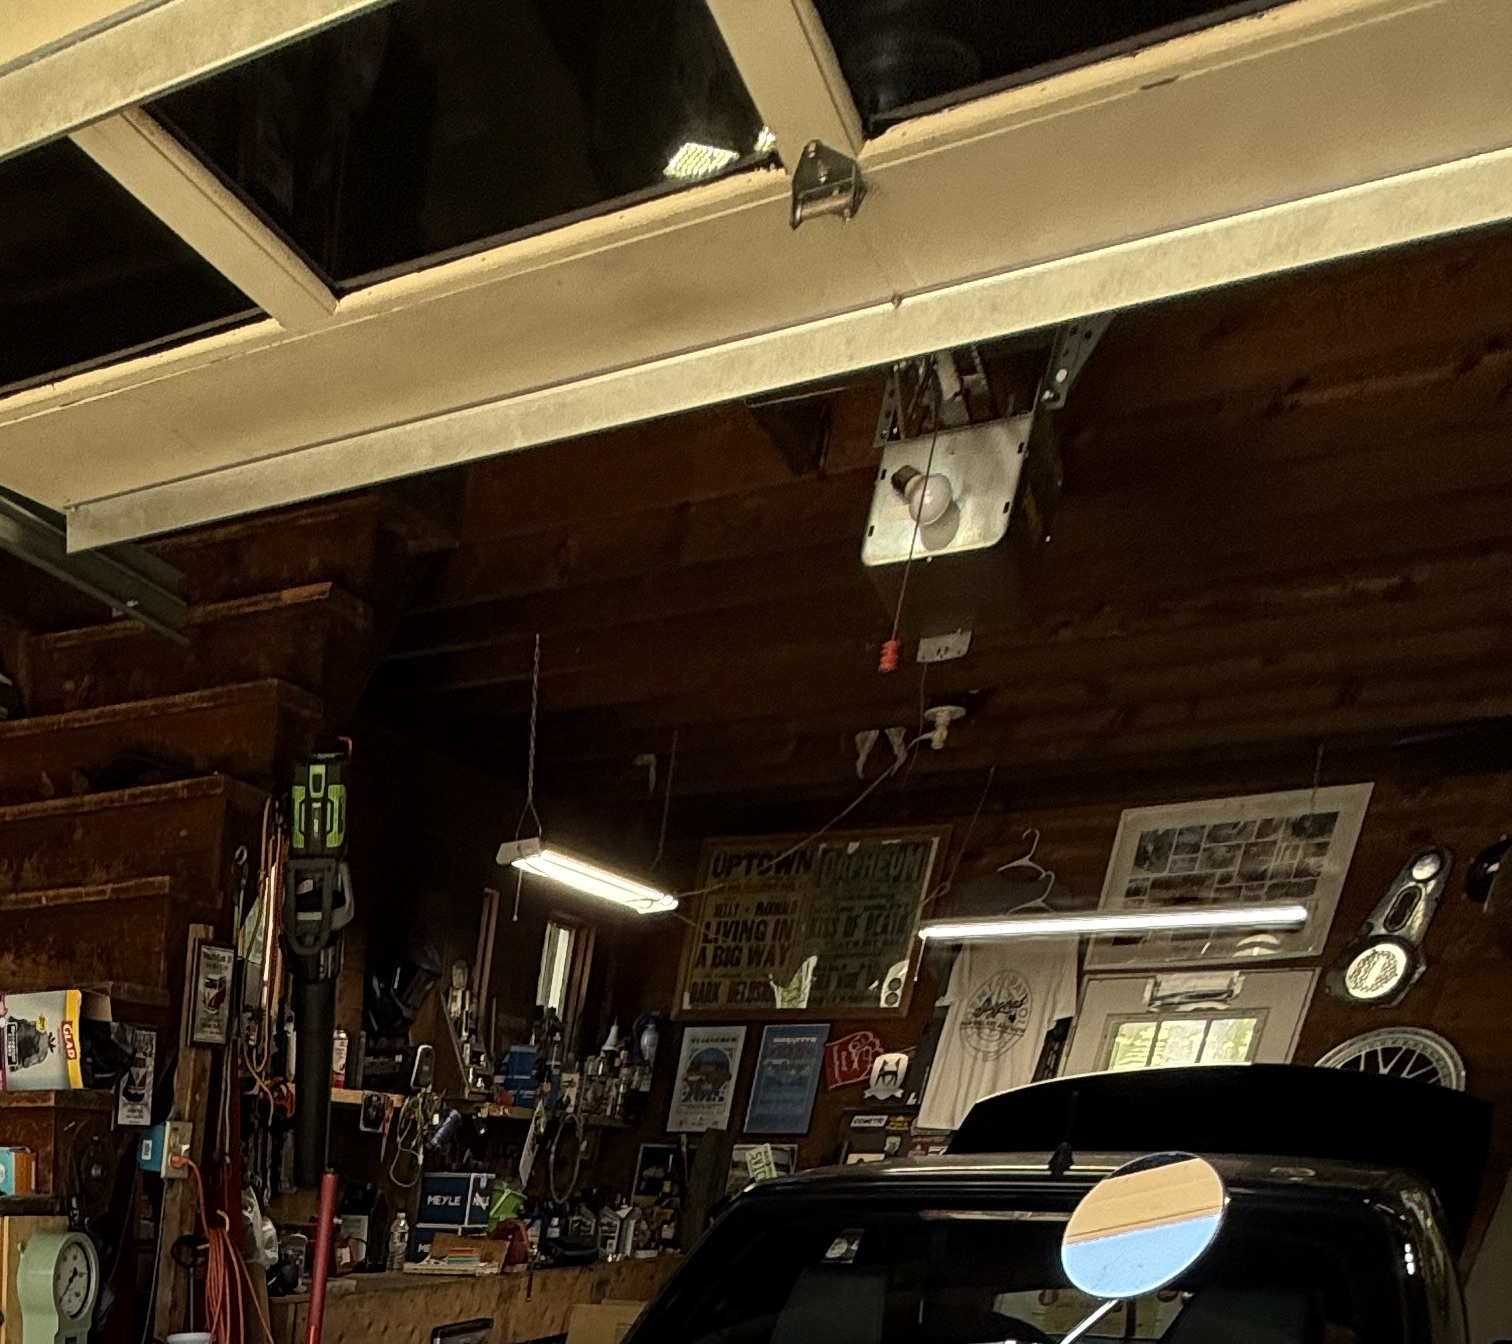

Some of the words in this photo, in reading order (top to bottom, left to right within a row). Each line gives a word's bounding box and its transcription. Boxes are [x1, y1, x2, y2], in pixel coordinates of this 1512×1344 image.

[711, 850, 814, 878] UPTOWN
[702, 919, 768, 944] LIVING
[771, 917, 796, 942] IN
[695, 945, 708, 969] A
[711, 945, 744, 968] BIG
[747, 942, 790, 967] WAY
[63, 1022, 76, 1060] GLAD
[426, 1194, 462, 1207] MEYLE
